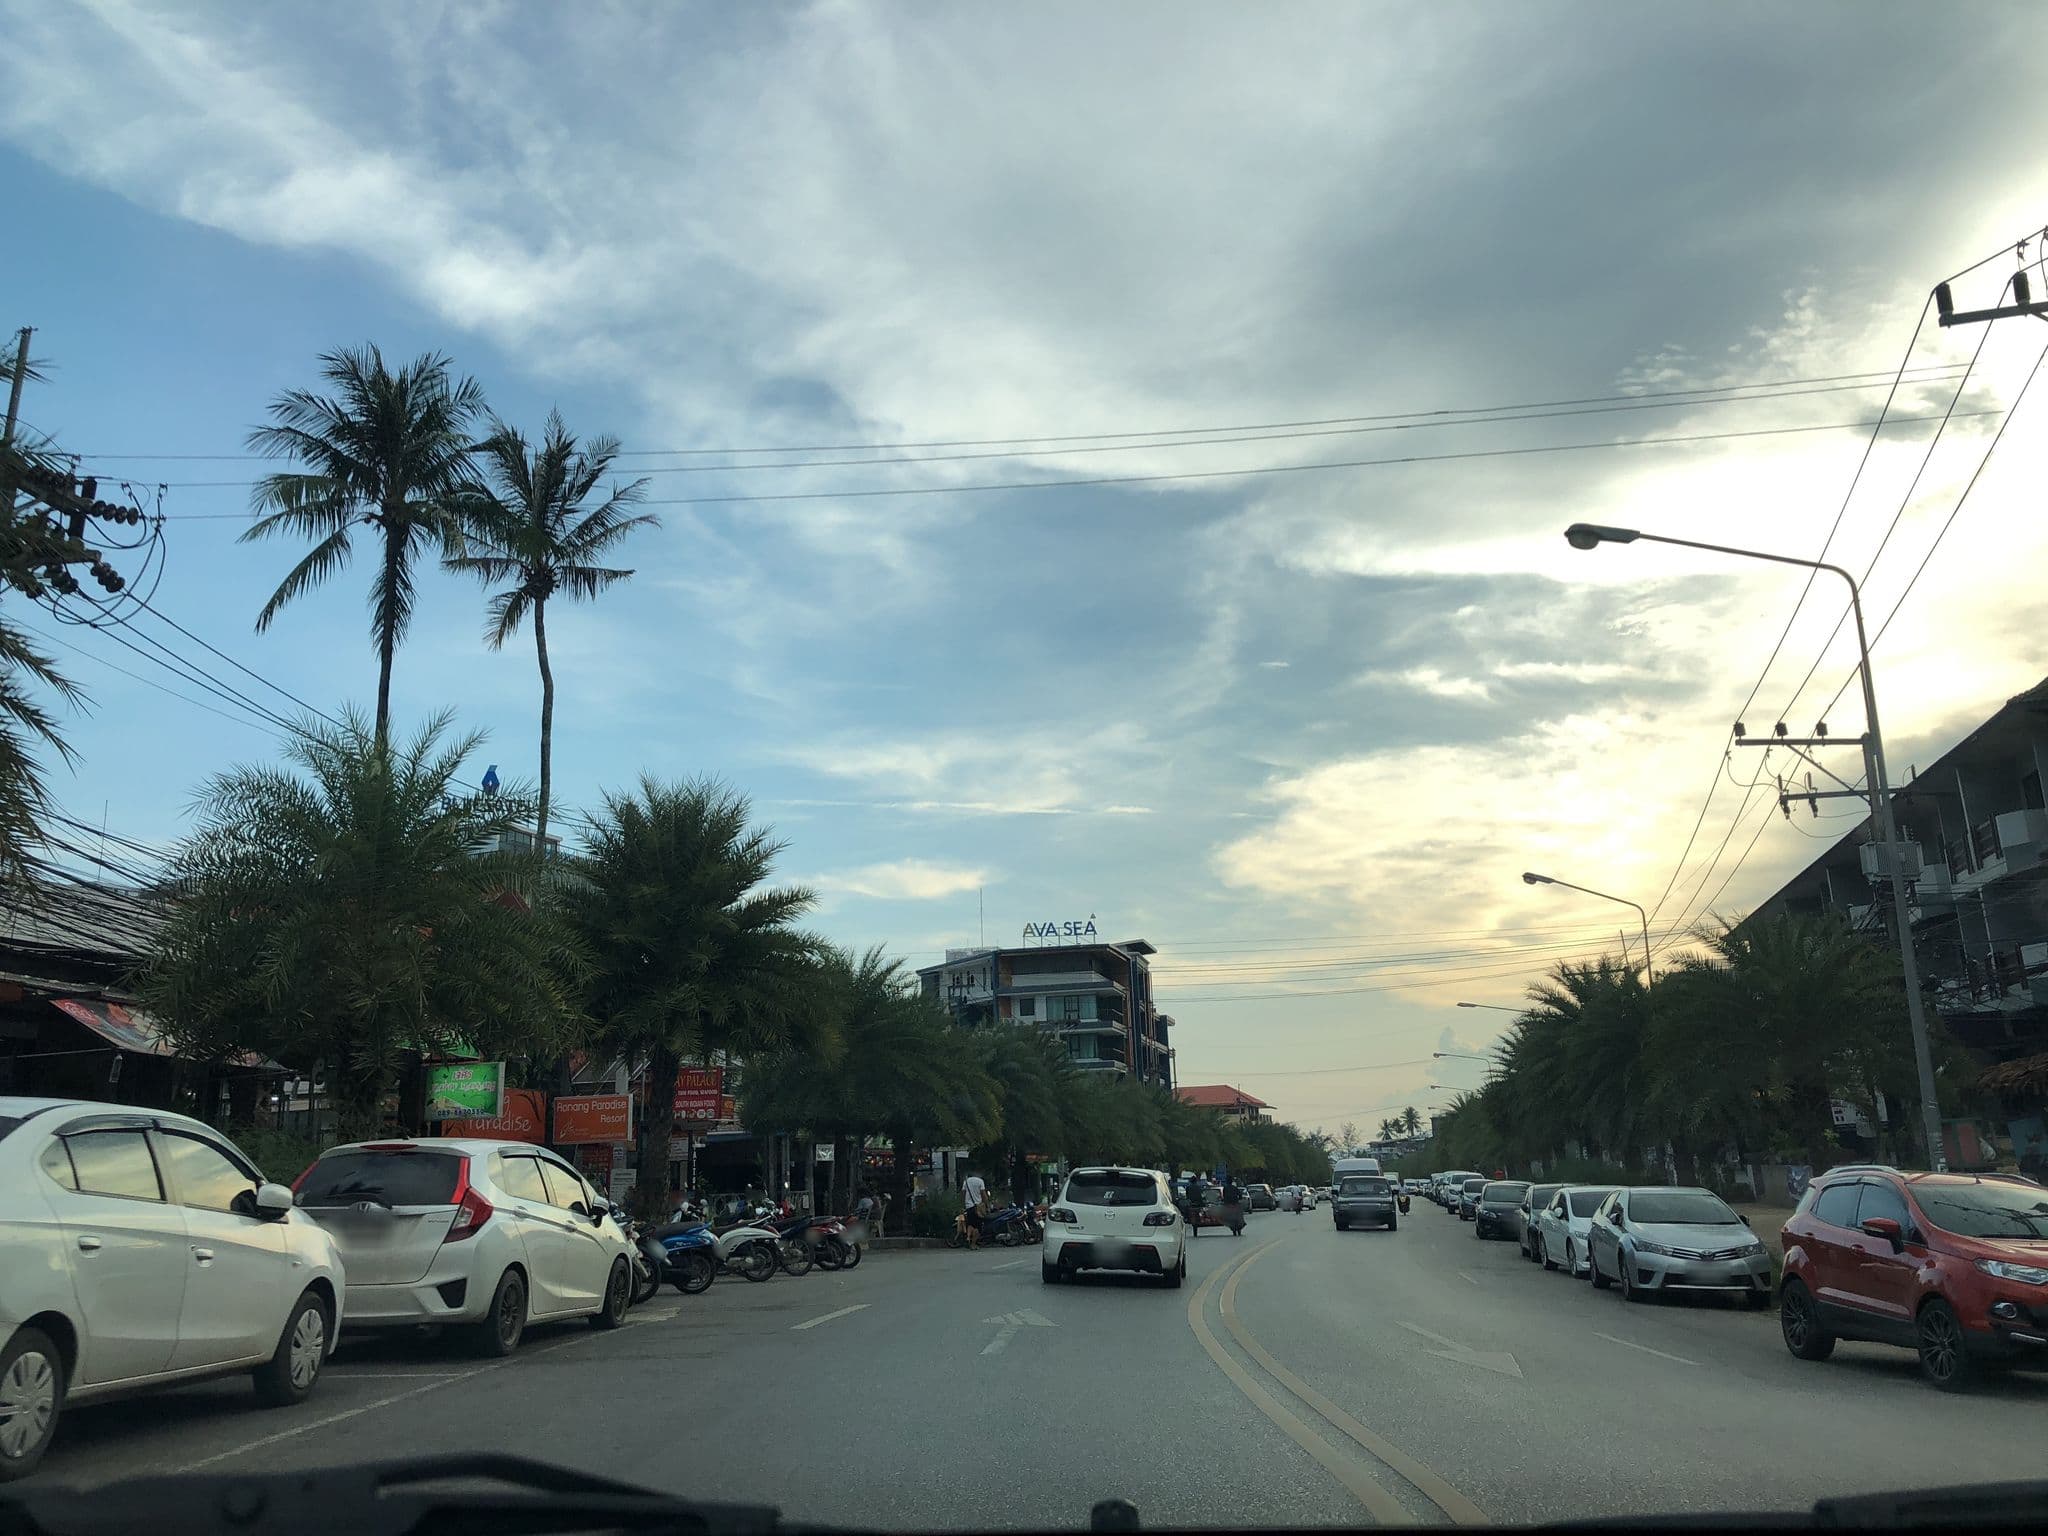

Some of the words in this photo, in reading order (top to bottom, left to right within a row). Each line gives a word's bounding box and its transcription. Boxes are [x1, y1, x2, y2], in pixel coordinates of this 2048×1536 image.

[1022, 922, 1058, 937] AVA
[1063, 920, 1098, 937] SEA
[687, 1074, 717, 1088] PALACE
[556, 1102, 590, 1114] Aonang
[591, 1099, 628, 1111] Paradise
[675, 1100, 689, 1108] SOUTH
[704, 1099, 716, 1107] FOOD
[600, 1114, 626, 1123] Resort
